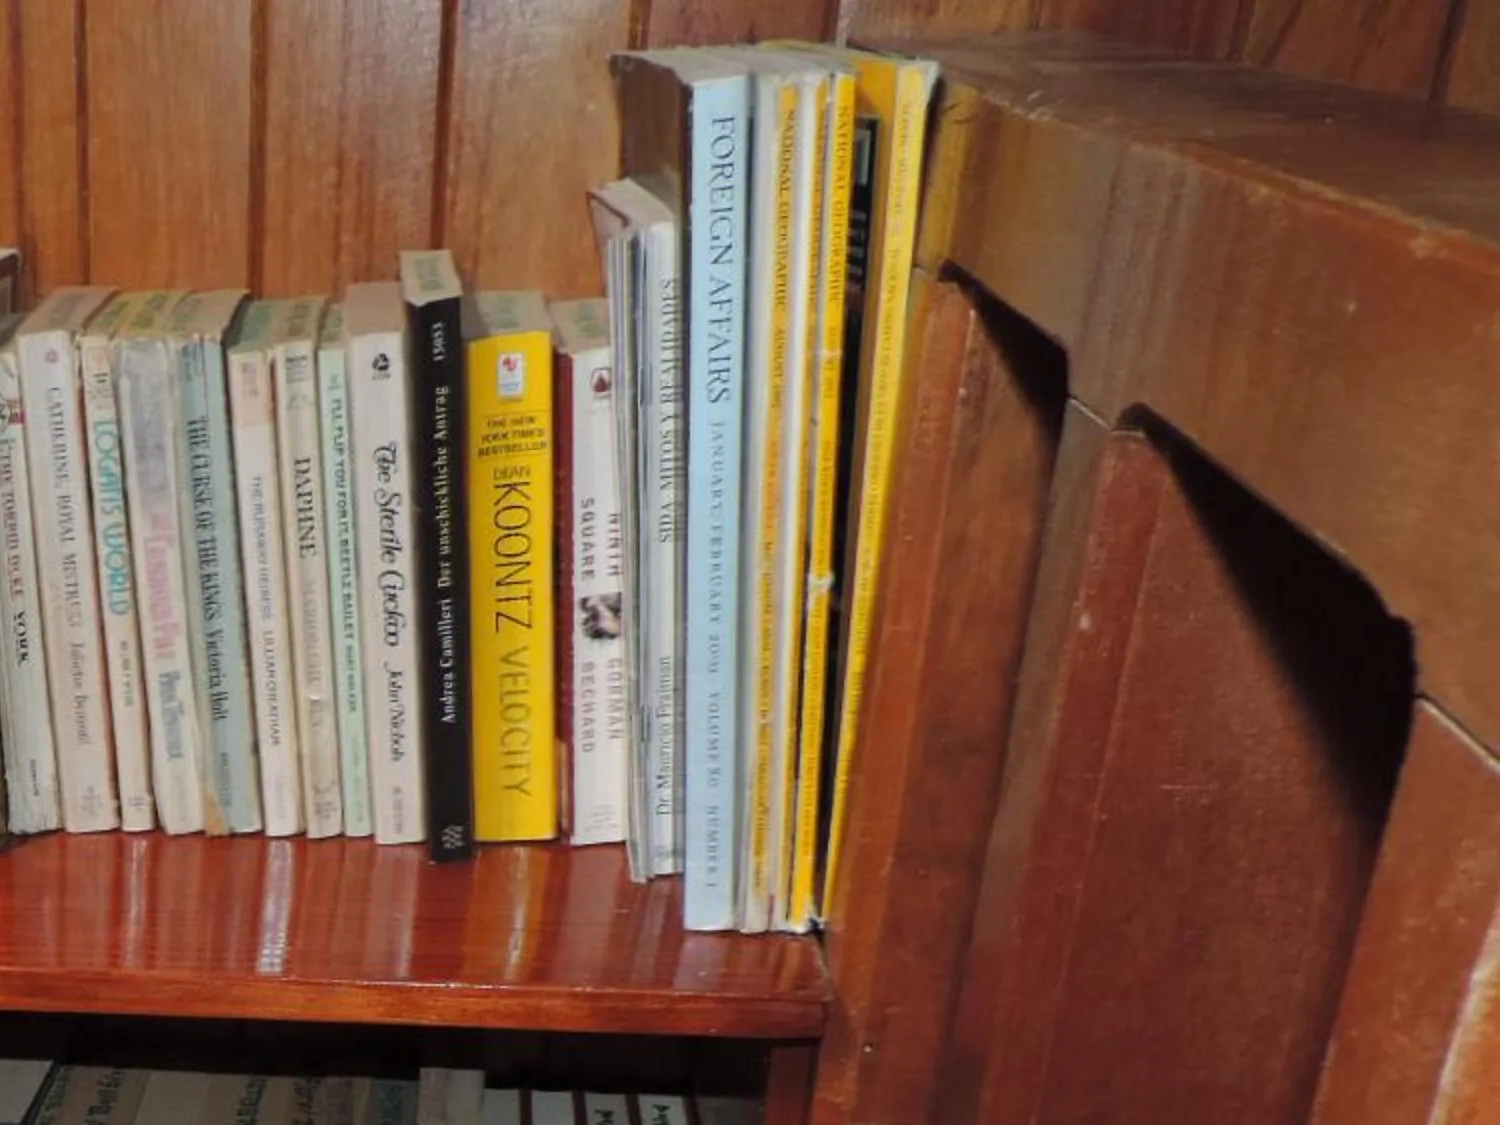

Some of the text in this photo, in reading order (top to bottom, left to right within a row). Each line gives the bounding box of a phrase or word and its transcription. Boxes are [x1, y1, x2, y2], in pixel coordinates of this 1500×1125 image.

[705, 116, 736, 404] FOREIGN AFFAIRS
[184, 415, 210, 455] THE
[370, 442, 400, 484] The
[186, 452, 214, 510] CURSE
[291, 457, 318, 559] DAPHNE
[192, 509, 215, 534] OF
[195, 535, 218, 571] THE
[371, 487, 407, 565] Sterile
[430, 385, 455, 723] Andrea Camilleri Der unschickliche Antrag
[578, 497, 596, 581] SQUARE
[197, 571, 223, 622] KINGS
[374, 568, 410, 648] Cuckoo
[493, 481, 532, 796] KOONTZ VELOCITY
